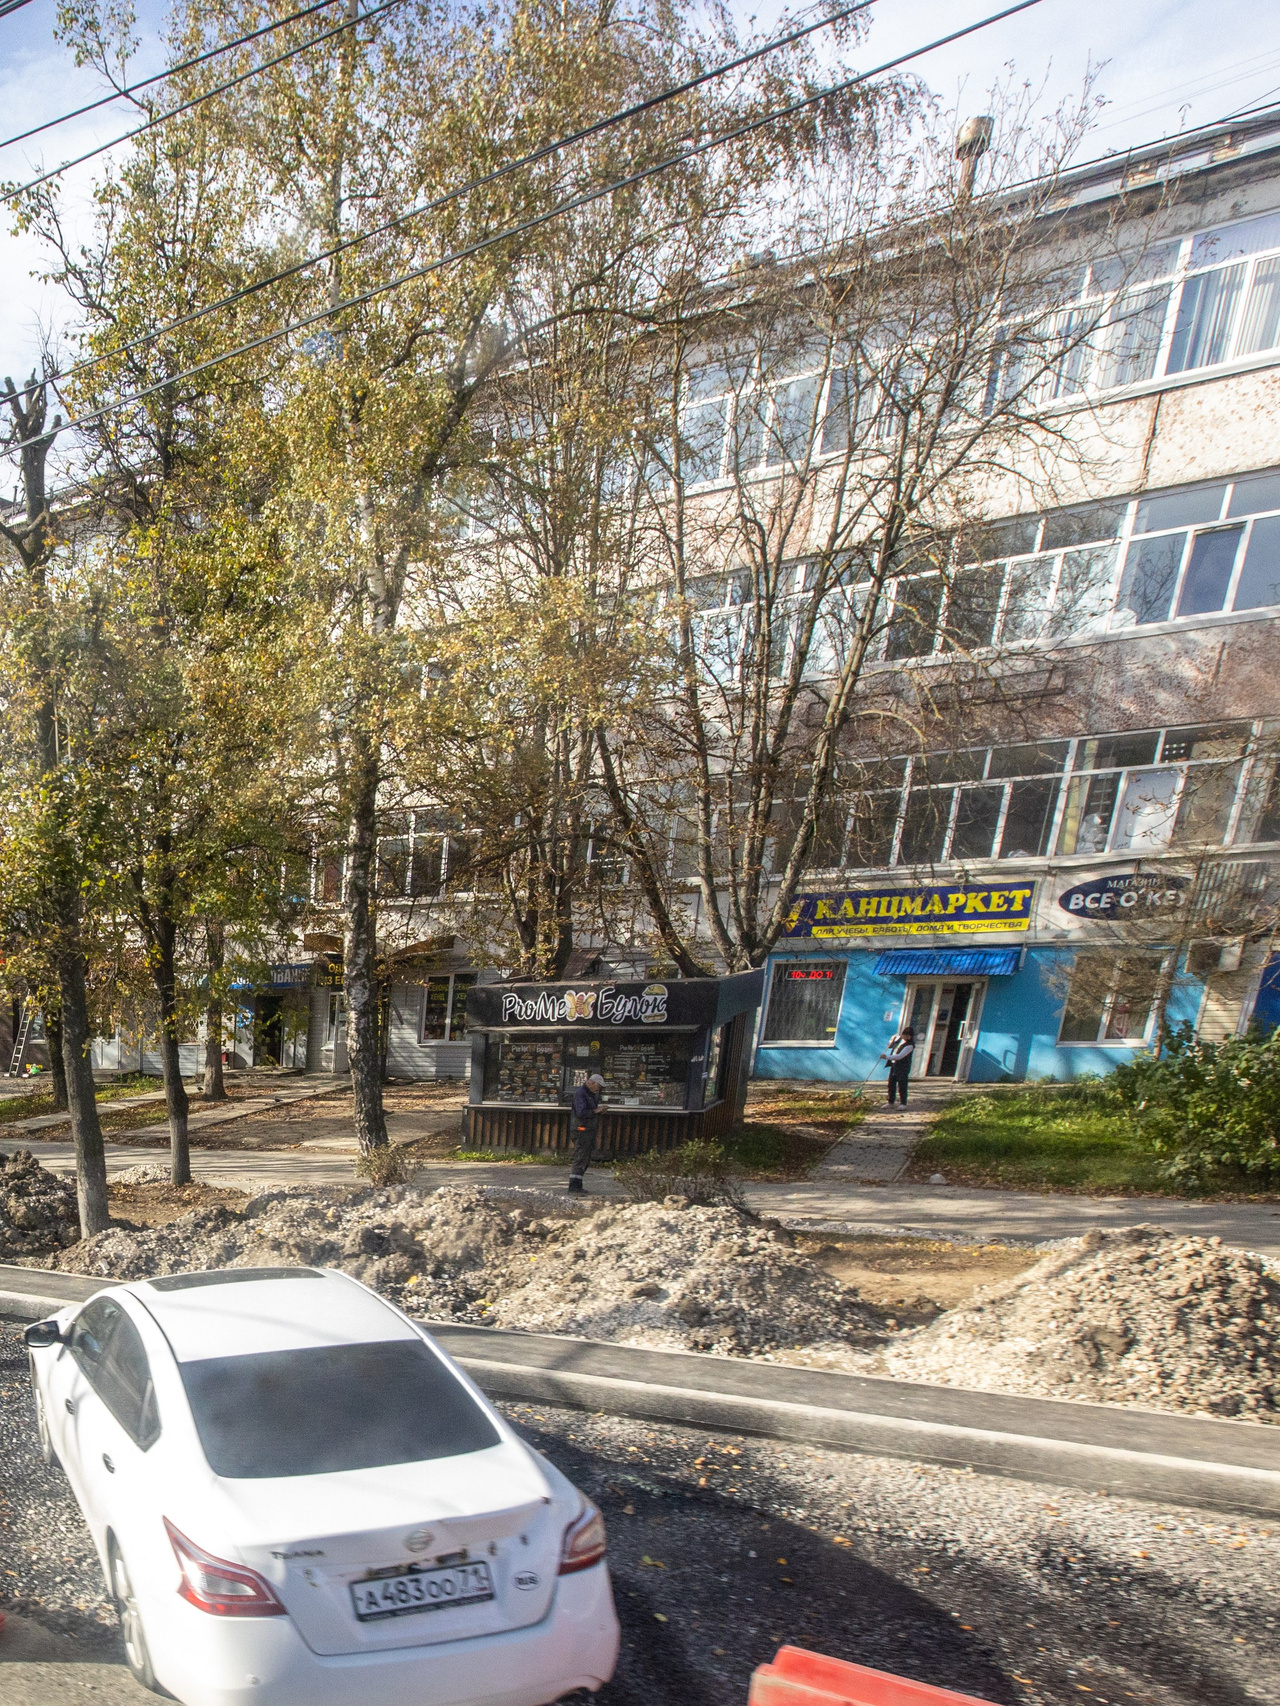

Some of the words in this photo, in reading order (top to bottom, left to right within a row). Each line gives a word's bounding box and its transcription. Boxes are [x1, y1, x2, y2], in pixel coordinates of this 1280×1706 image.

[1107, 878, 1160, 888] МАГАЗИН
[814, 889, 1031, 919] КАНЦМАРКЕТ
[1069, 892, 1114, 910] ВСЕ
[916, 924, 944, 932] ДОМА
[957, 921, 1023, 930] ТВОРЧЕСТВА
[809, 970, 824, 980] ДО
[598, 985, 669, 1023] Булок
